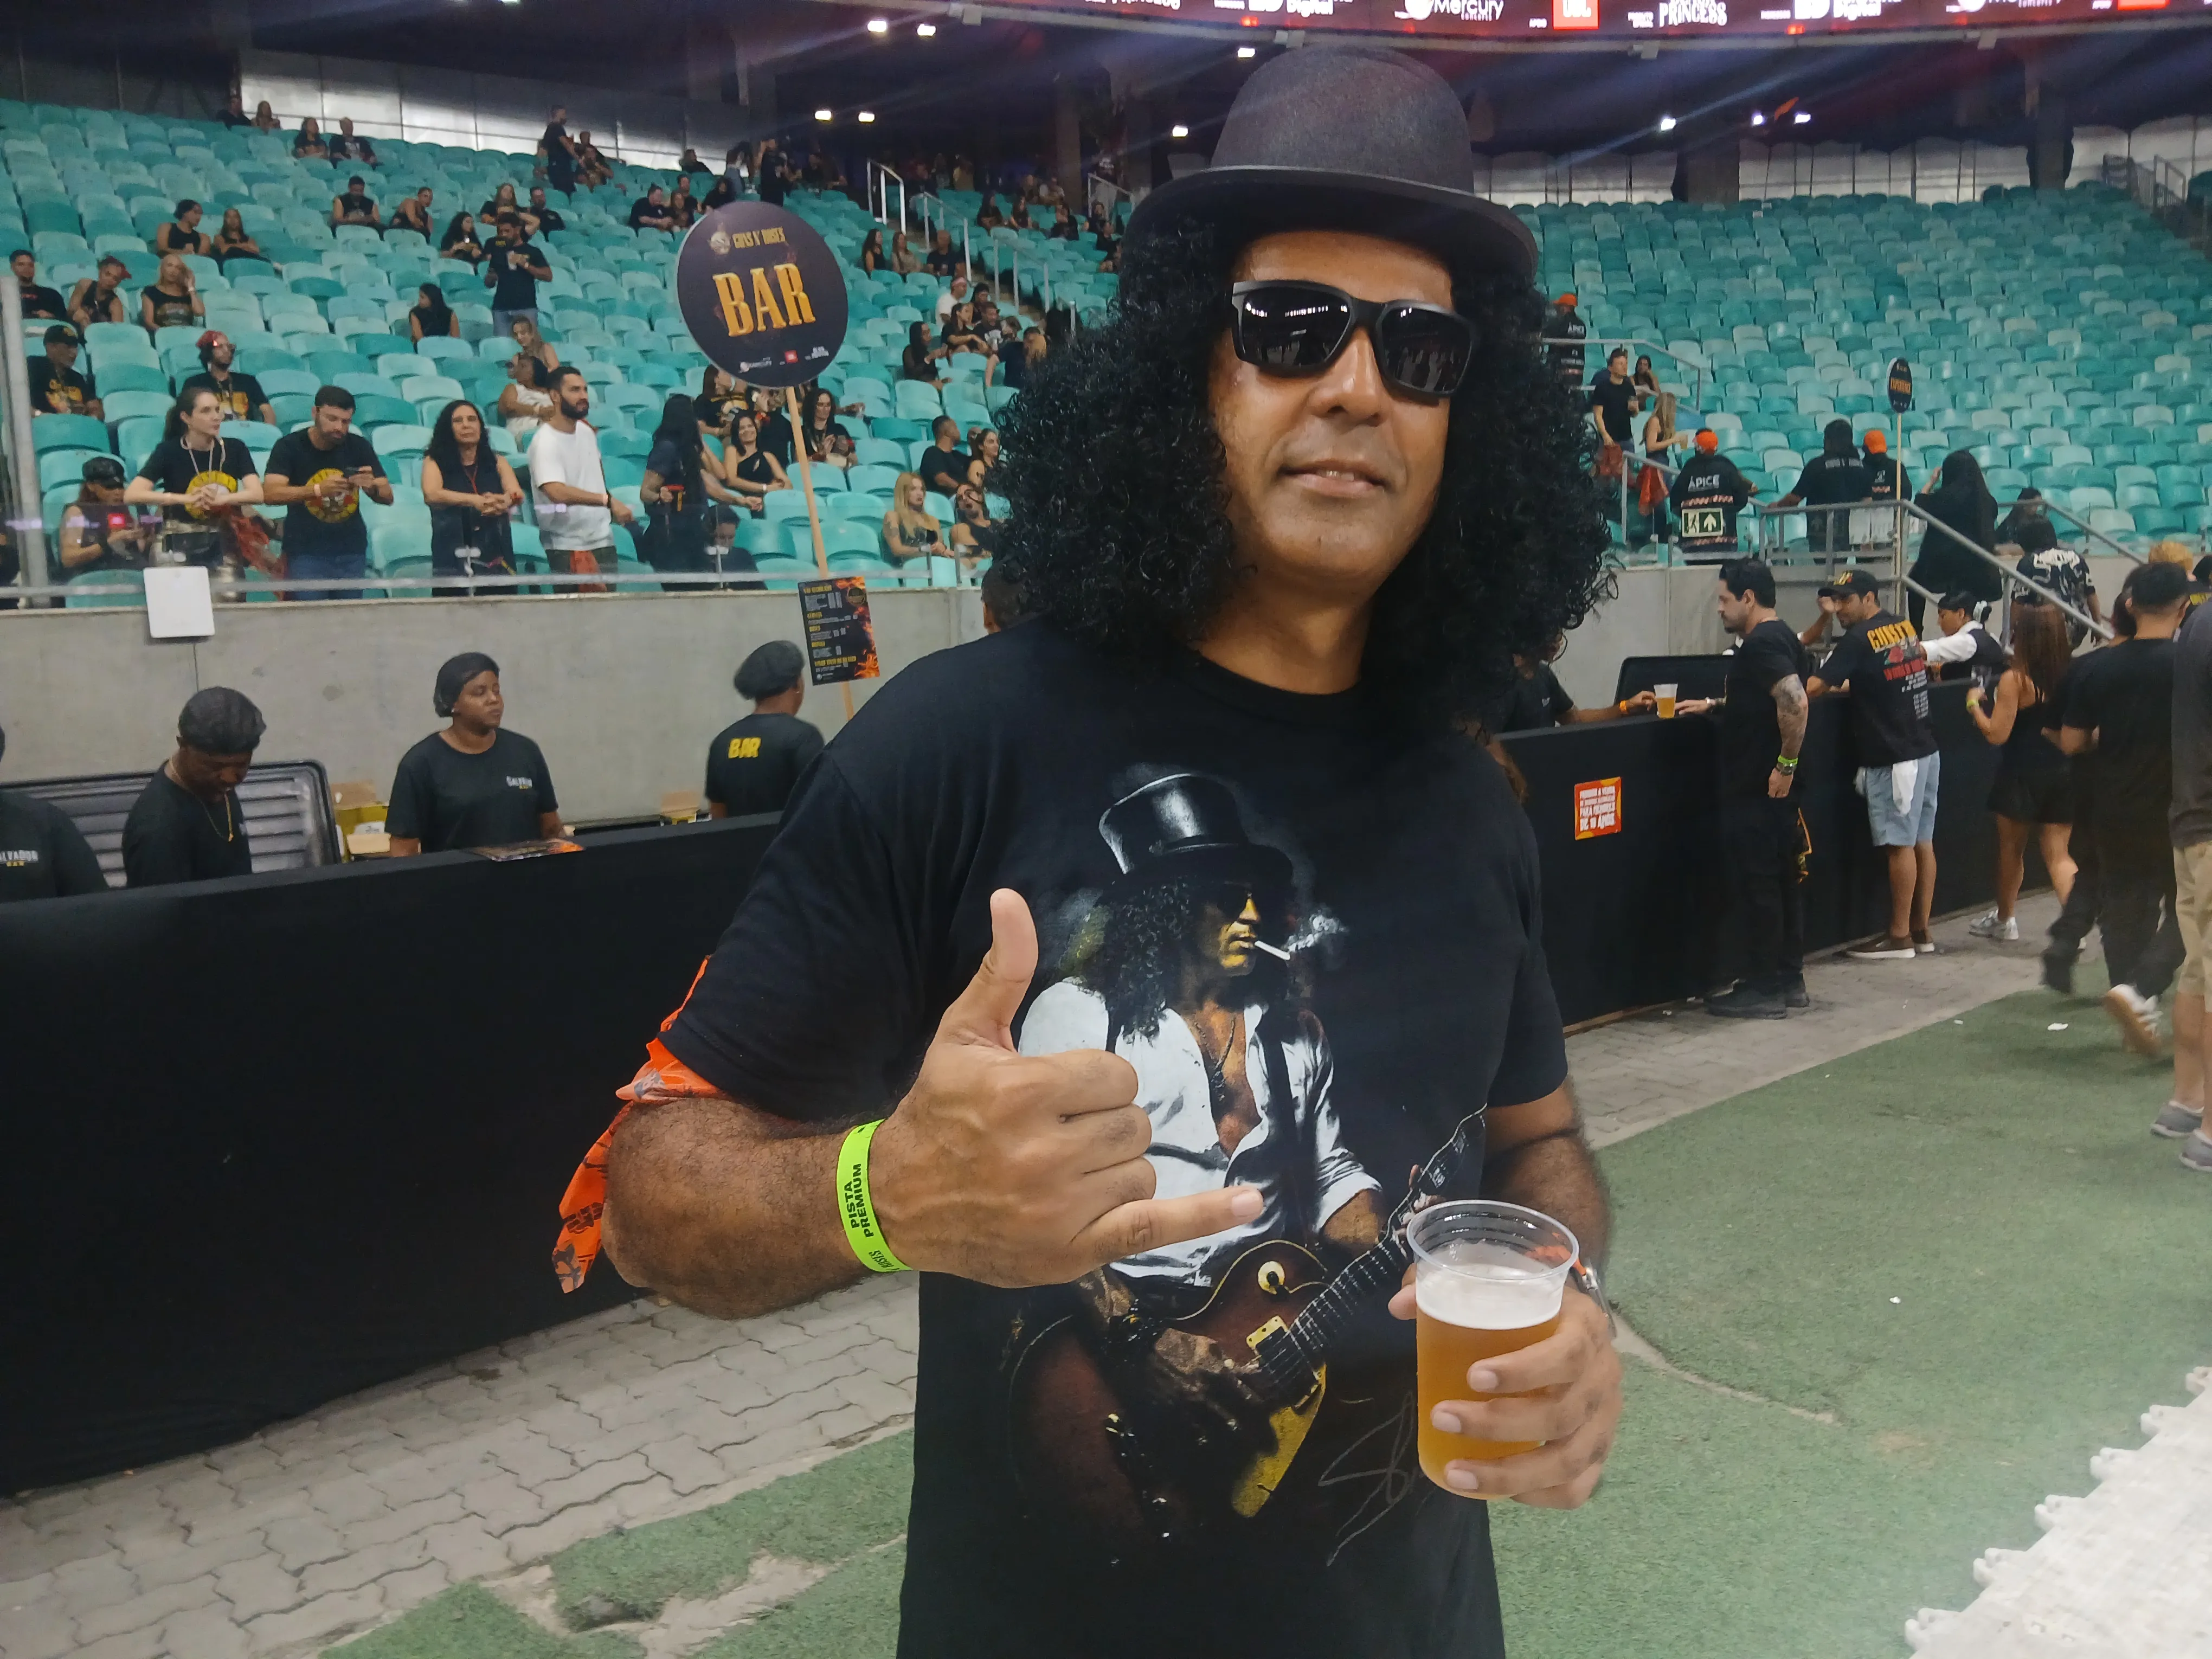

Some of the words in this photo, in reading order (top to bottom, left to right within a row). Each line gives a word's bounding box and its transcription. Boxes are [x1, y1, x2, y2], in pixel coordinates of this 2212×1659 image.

[712, 263, 816, 337] BAR
[728, 737, 761, 759] BAR
[844, 1181, 860, 1229] PISTA
[853, 1163, 874, 1238] PREMIUM
